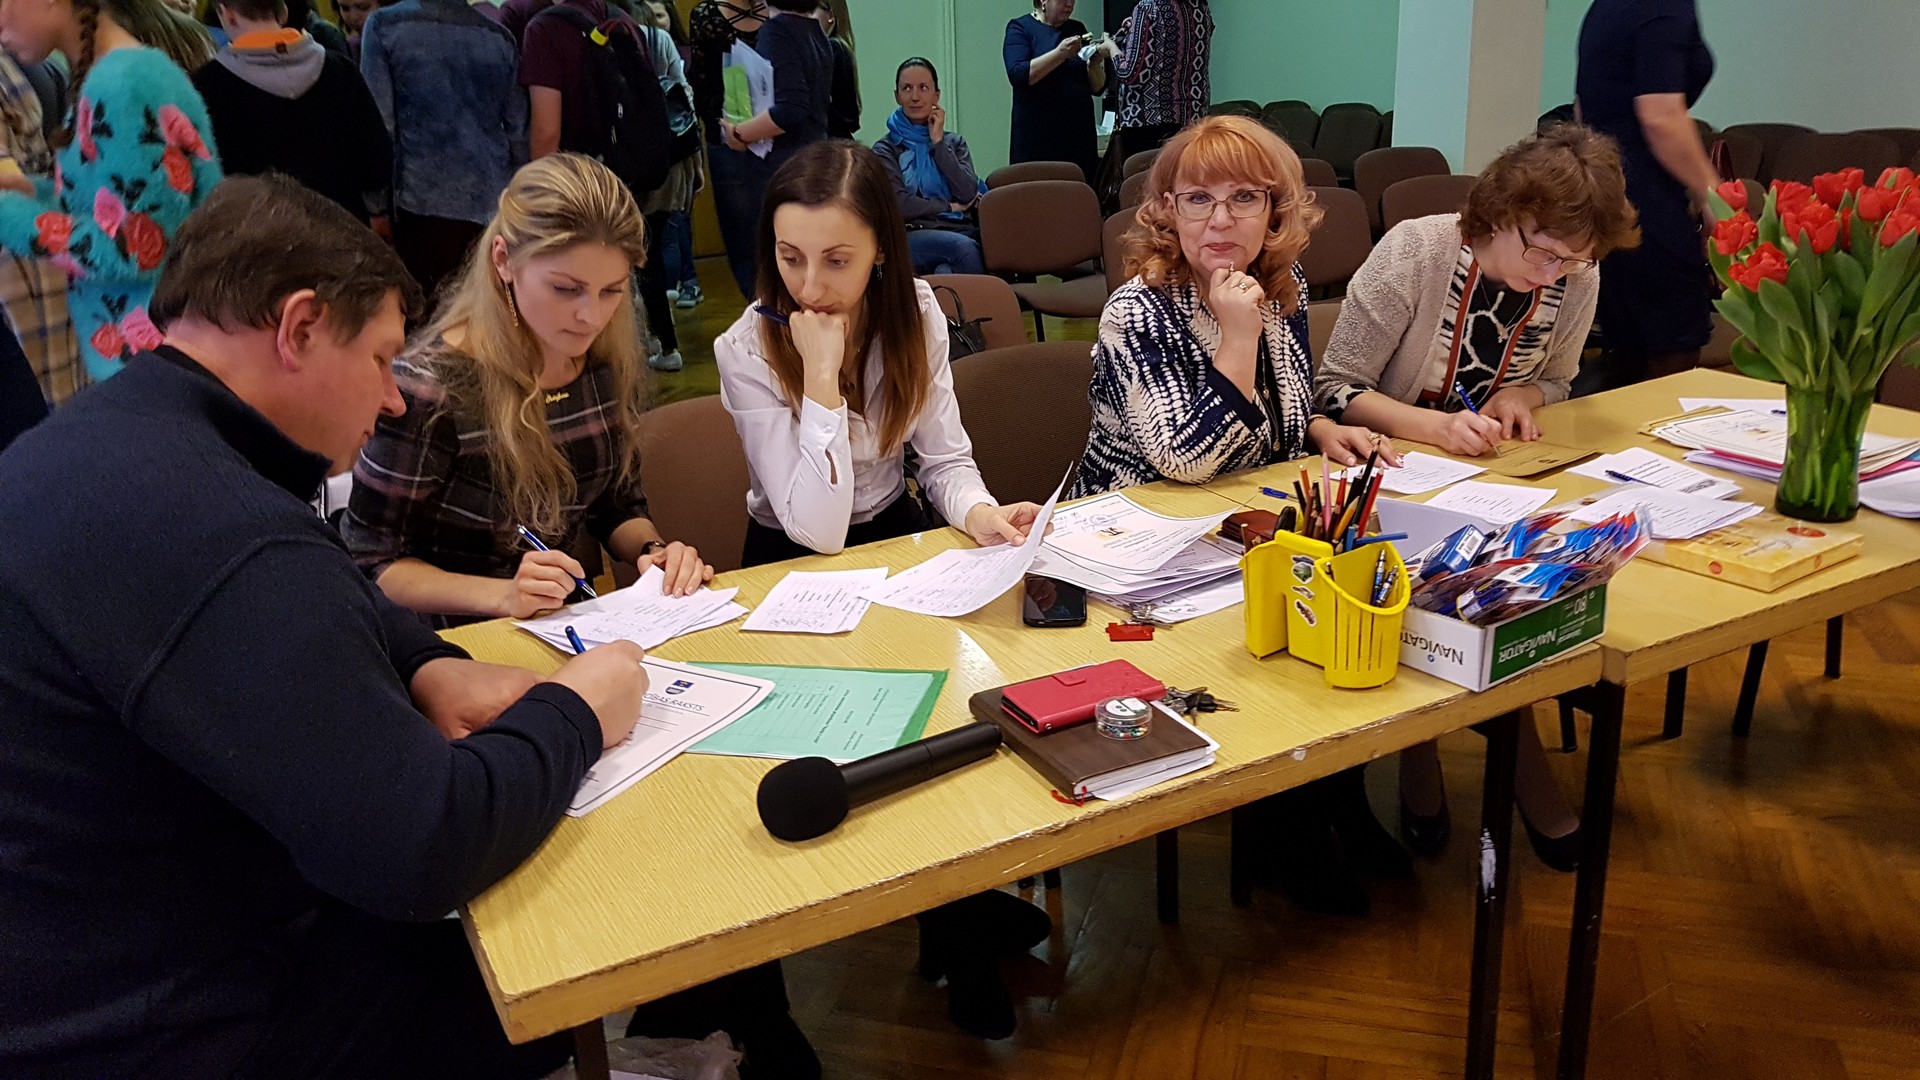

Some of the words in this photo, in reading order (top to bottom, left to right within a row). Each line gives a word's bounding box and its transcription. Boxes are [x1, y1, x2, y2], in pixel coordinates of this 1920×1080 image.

[1573, 595, 1588, 615] 80
[1400, 632, 1464, 665] NAVIGAT
[1497, 628, 1557, 664] NAVIGATOR
